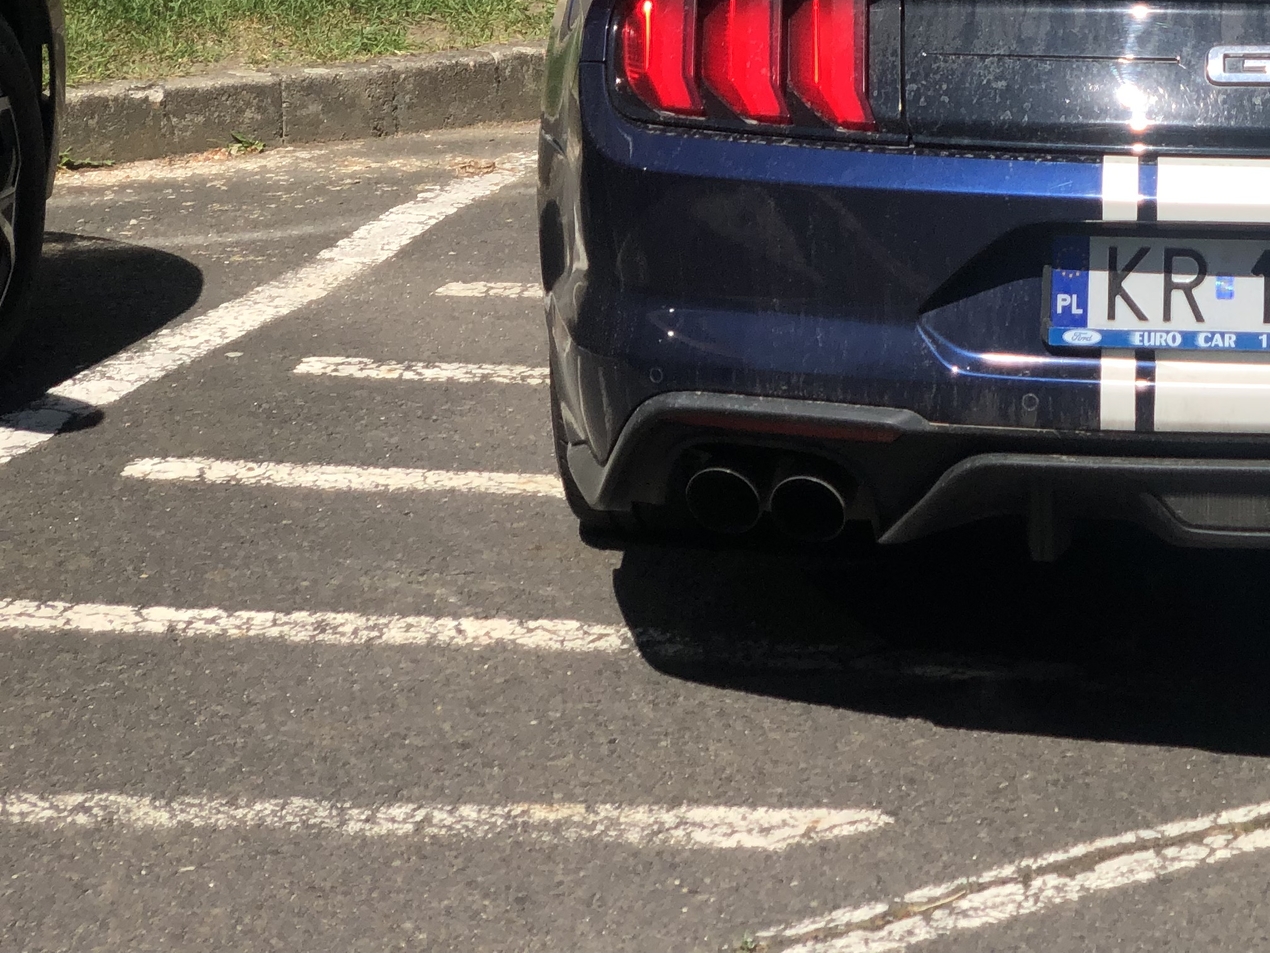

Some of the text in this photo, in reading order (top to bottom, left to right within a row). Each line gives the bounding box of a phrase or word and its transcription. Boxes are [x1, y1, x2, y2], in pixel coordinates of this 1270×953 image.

[1107, 246, 1206, 323] KR
[1057, 293, 1083, 315] PL
[1134, 331, 1182, 346] EURO
[1198, 333, 1236, 348] CAR
